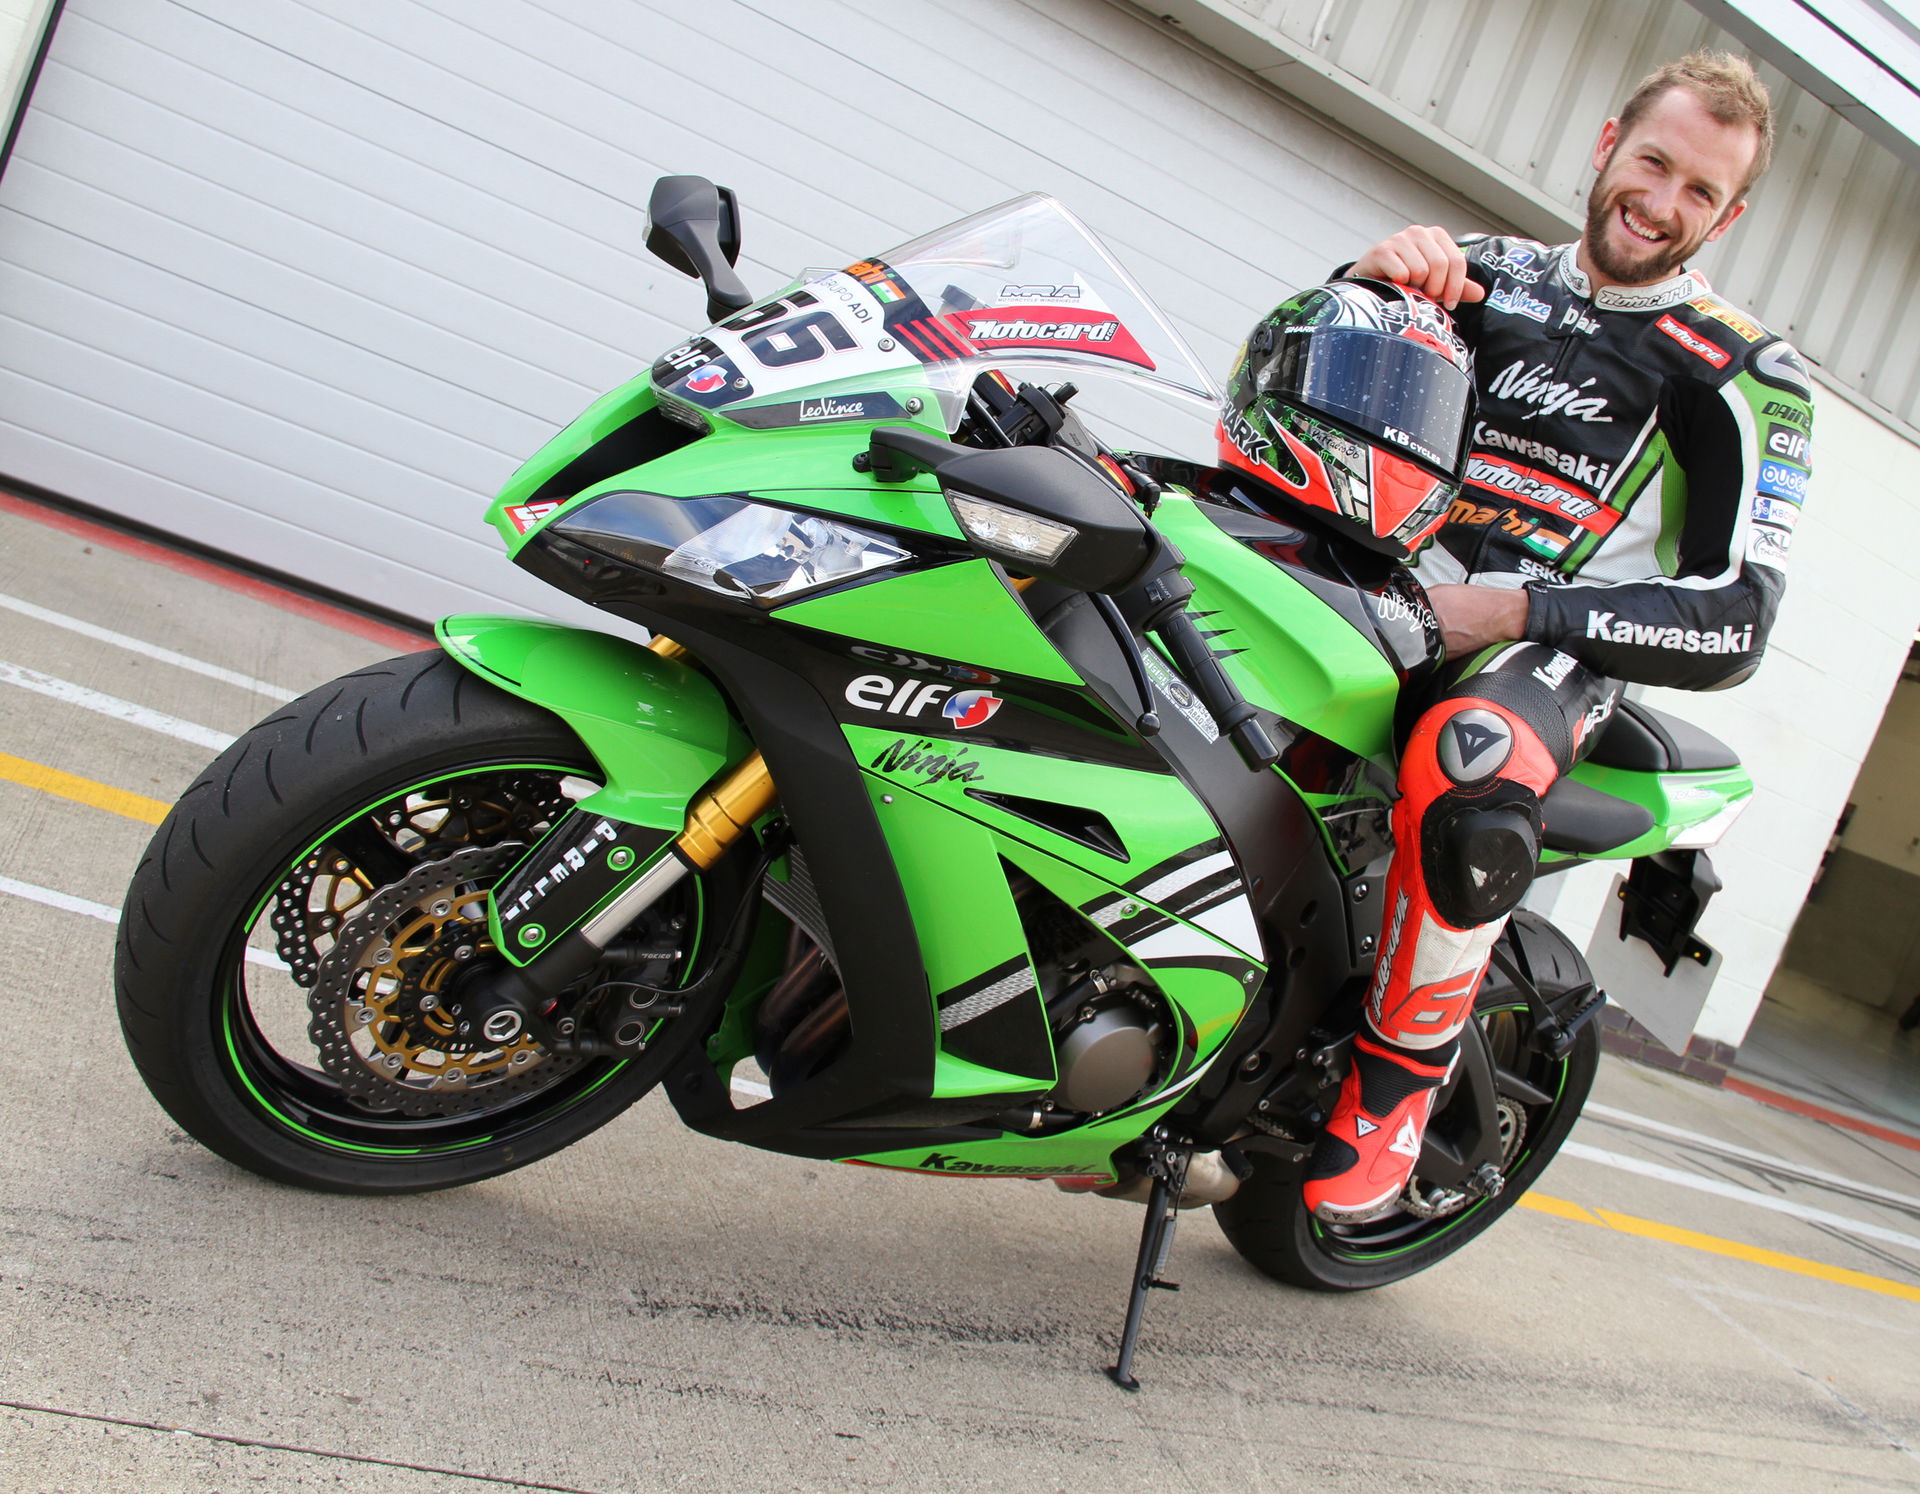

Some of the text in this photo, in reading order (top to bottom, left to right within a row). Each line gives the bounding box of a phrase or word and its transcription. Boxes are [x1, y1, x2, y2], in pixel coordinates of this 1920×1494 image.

[1000, 285, 1081, 298] MRA
[1487, 278, 1552, 317] LeoVince
[848, 303, 873, 323] ADI
[1284, 326, 1319, 334] SHARK
[664, 345, 711, 371] elf
[1489, 360, 1613, 423] Ninja
[800, 398, 864, 419] LeoVince
[1221, 401, 1272, 466] HARK
[1383, 426, 1410, 446] KB
[1769, 431, 1805, 459] elf
[1378, 592, 1438, 633] Ninja
[1586, 610, 1753, 655] Kawasaki
[845, 674, 953, 718] elf
[871, 738, 984, 788] Ninja
[505, 820, 618, 921] PIRELLI
[918, 1152, 1096, 1174] Kawasaki
